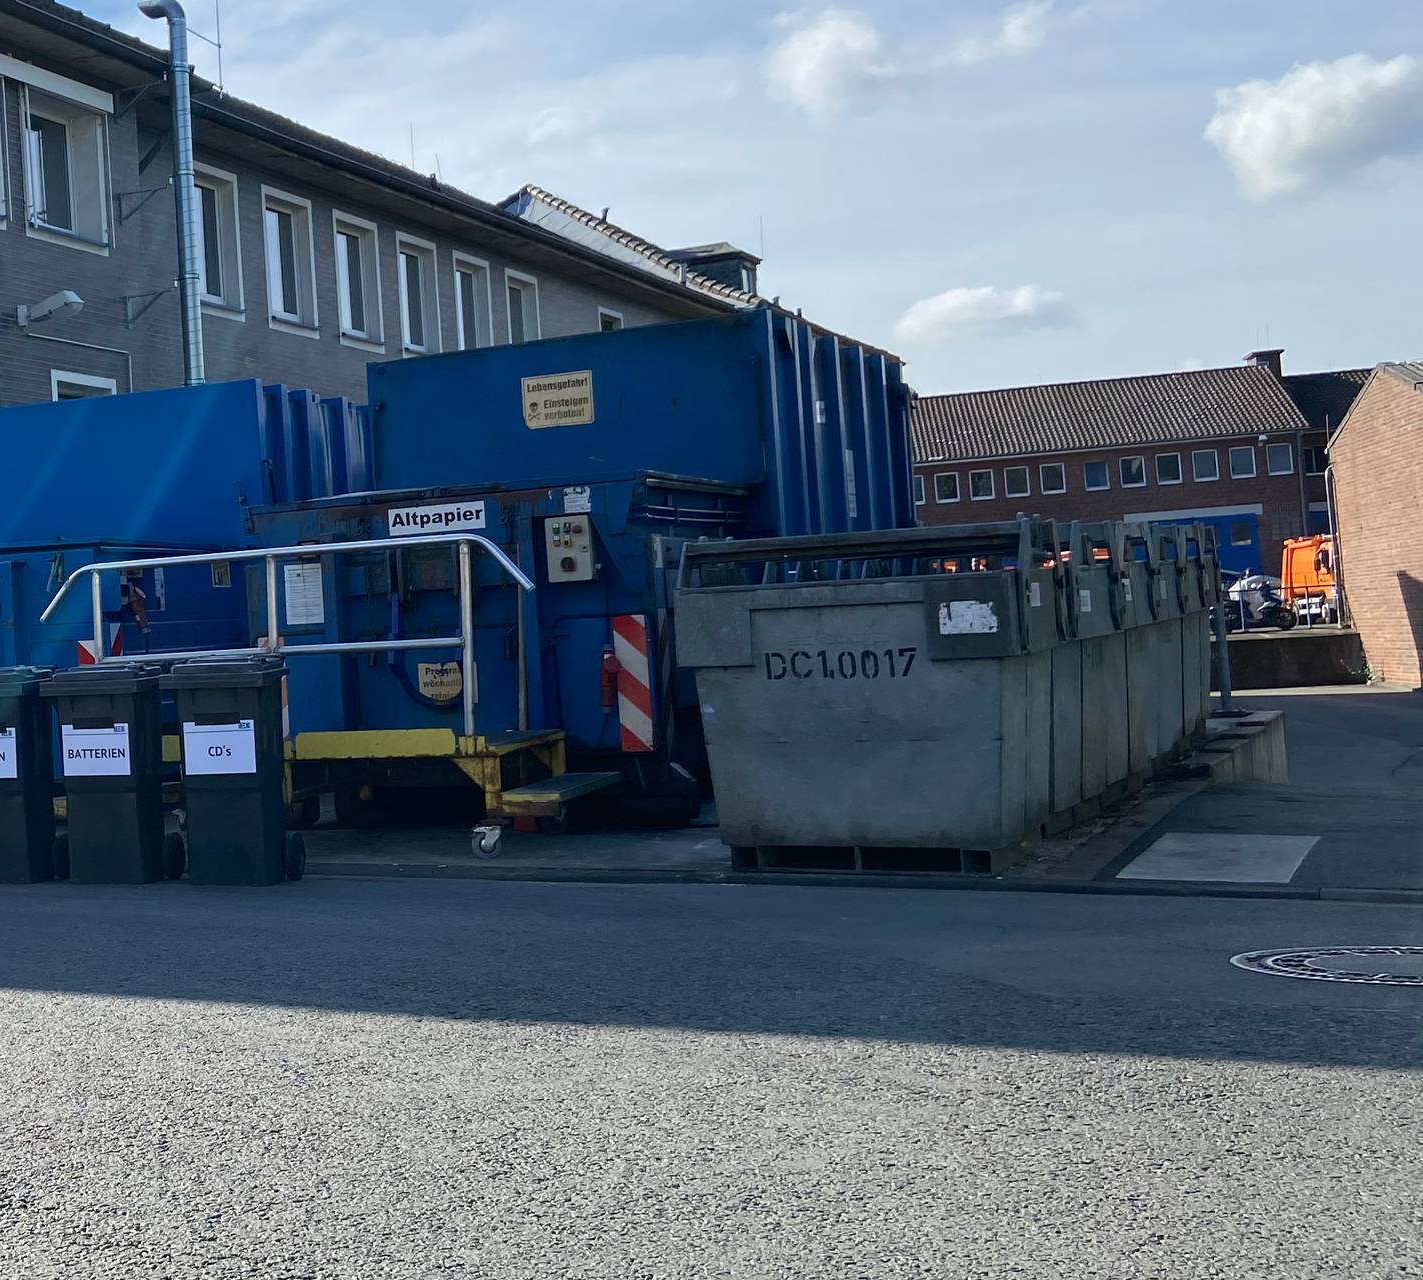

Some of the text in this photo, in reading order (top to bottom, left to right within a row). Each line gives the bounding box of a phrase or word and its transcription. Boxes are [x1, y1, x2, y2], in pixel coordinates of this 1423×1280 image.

[527, 378, 587, 393] Lebensgefahr!
[543, 396, 589, 409] Einsteigen
[391, 507, 483, 529] Altpapier
[67, 748, 126, 759] BATTERIEN
